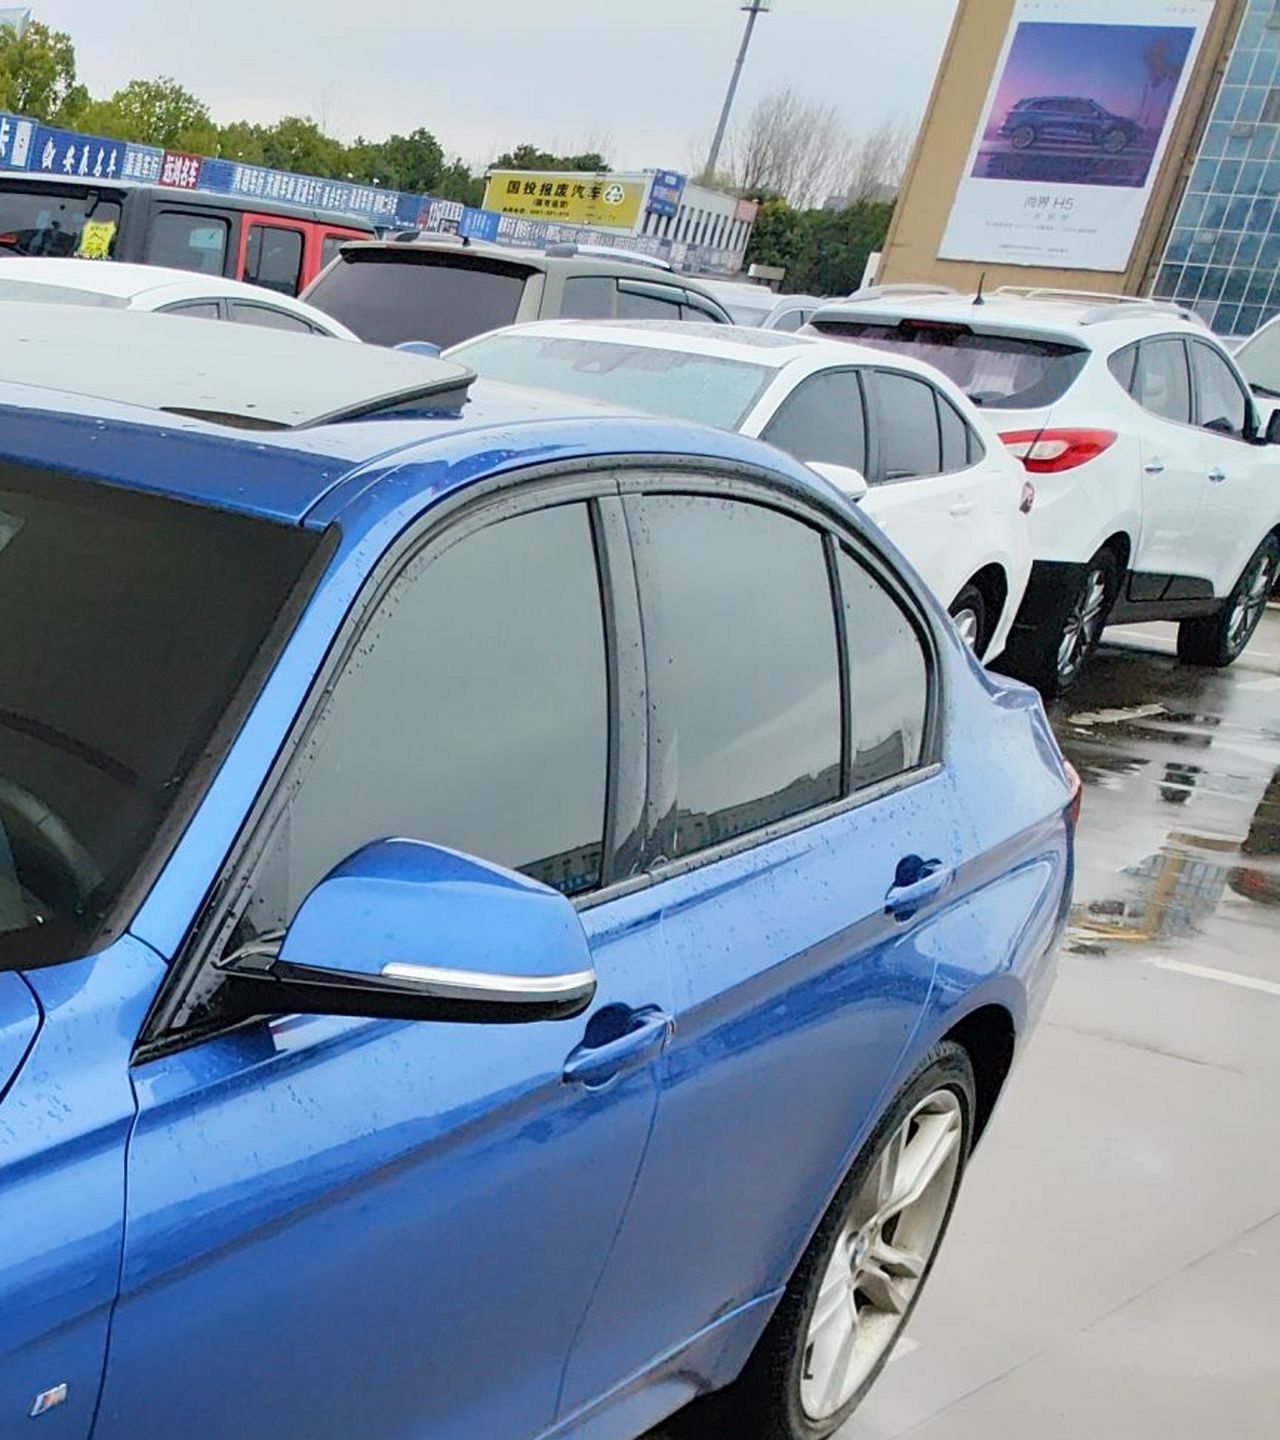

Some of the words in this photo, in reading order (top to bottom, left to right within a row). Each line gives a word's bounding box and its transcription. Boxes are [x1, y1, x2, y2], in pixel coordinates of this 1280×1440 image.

[506, 179, 603, 200] 国投报废汽车
